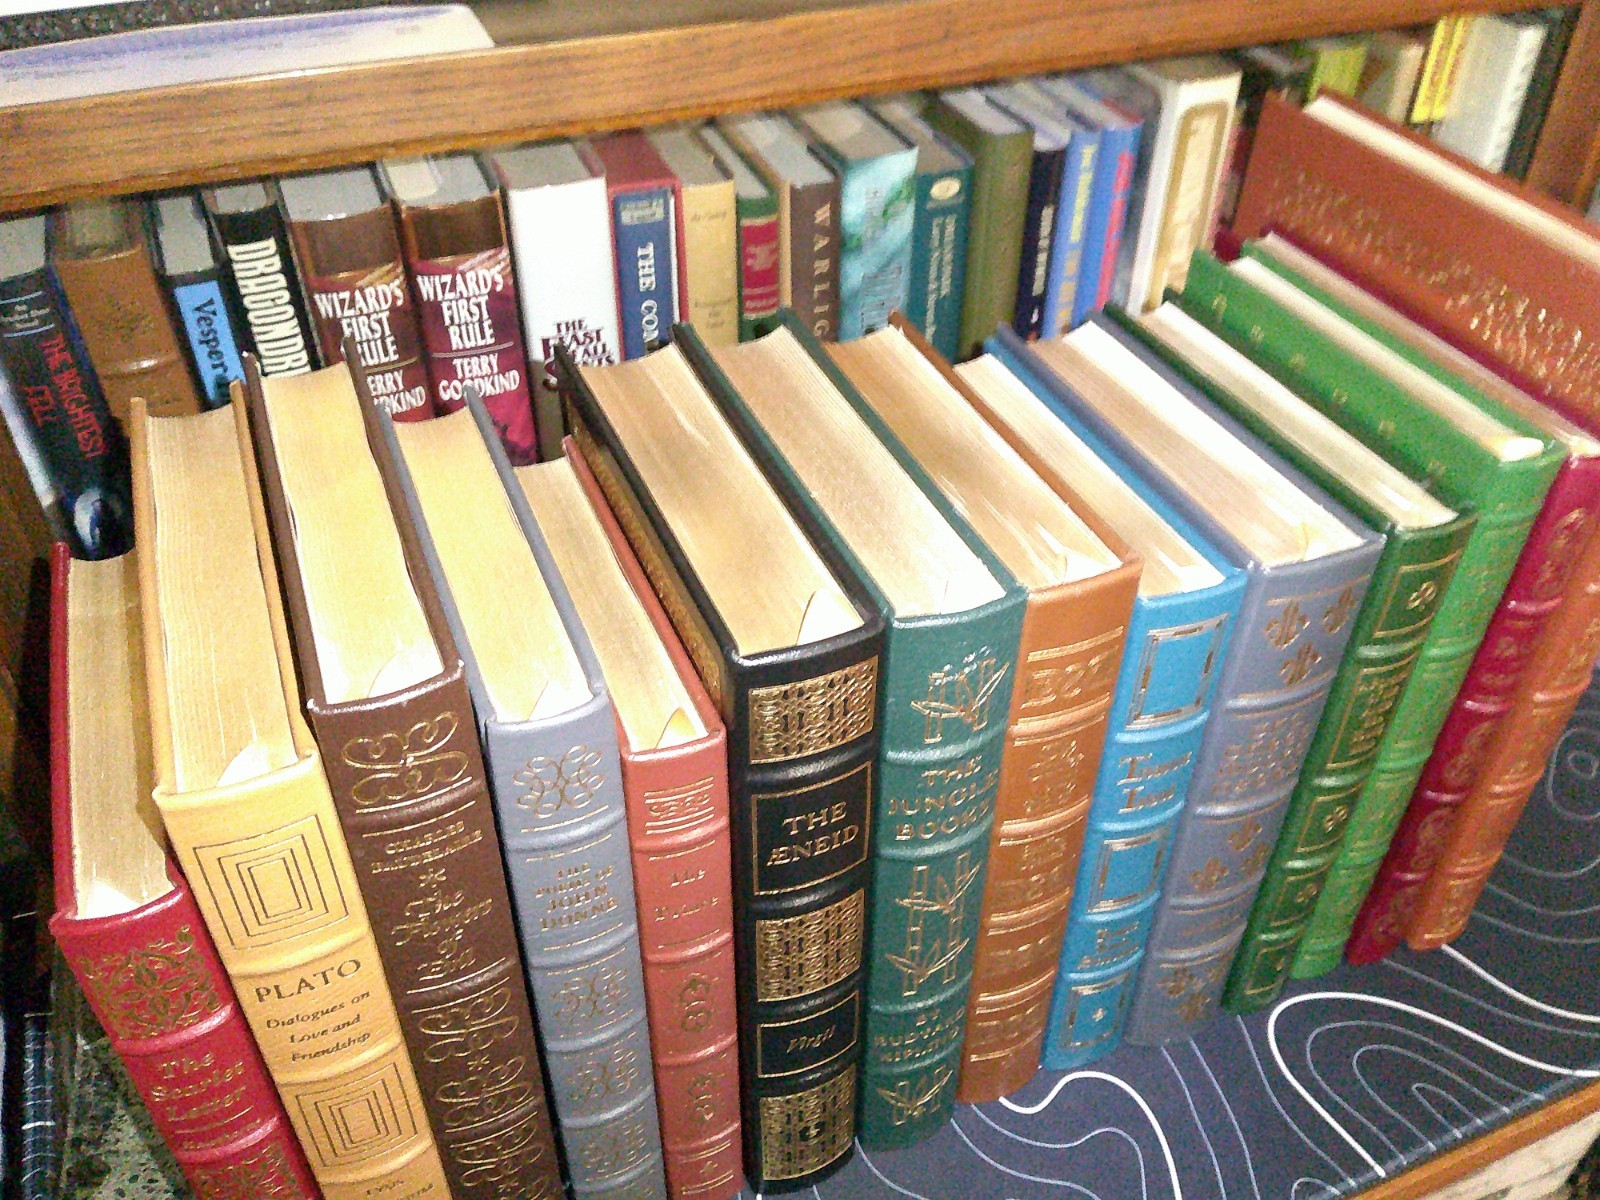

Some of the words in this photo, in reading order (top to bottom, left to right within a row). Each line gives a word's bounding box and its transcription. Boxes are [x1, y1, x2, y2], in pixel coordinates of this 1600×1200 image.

[416, 265, 504, 302] WIZARD'S
[637, 241, 656, 292] THE
[313, 279, 404, 320] WIZARD'S
[440, 295, 489, 327] FIRST
[340, 310, 393, 342] FIRST
[448, 319, 496, 351] RULE
[554, 317, 587, 334] THE
[37, 332, 74, 372] THE
[452, 352, 499, 380] TERRY
[366, 369, 404, 397] ERRY
[52, 367, 109, 459] BRIGHTEST
[921, 755, 983, 786] THE
[888, 768, 999, 816] JUNGLE
[781, 800, 847, 836] THE
[766, 824, 859, 867] ÆNEID
[556, 860, 592, 881] THE
[539, 895, 619, 932] DONNE
[547, 882, 608, 914] JOHN
[254, 958, 362, 1003] PLATO
[266, 1001, 345, 1029] Dialogues
[351, 991, 370, 1005] on
[290, 1027, 330, 1044] Love
[331, 1014, 361, 1033] and
[290, 1031, 371, 1062] Friendship
[152, 1060, 244, 1102] Scarlet
[157, 1052, 215, 1080] The
